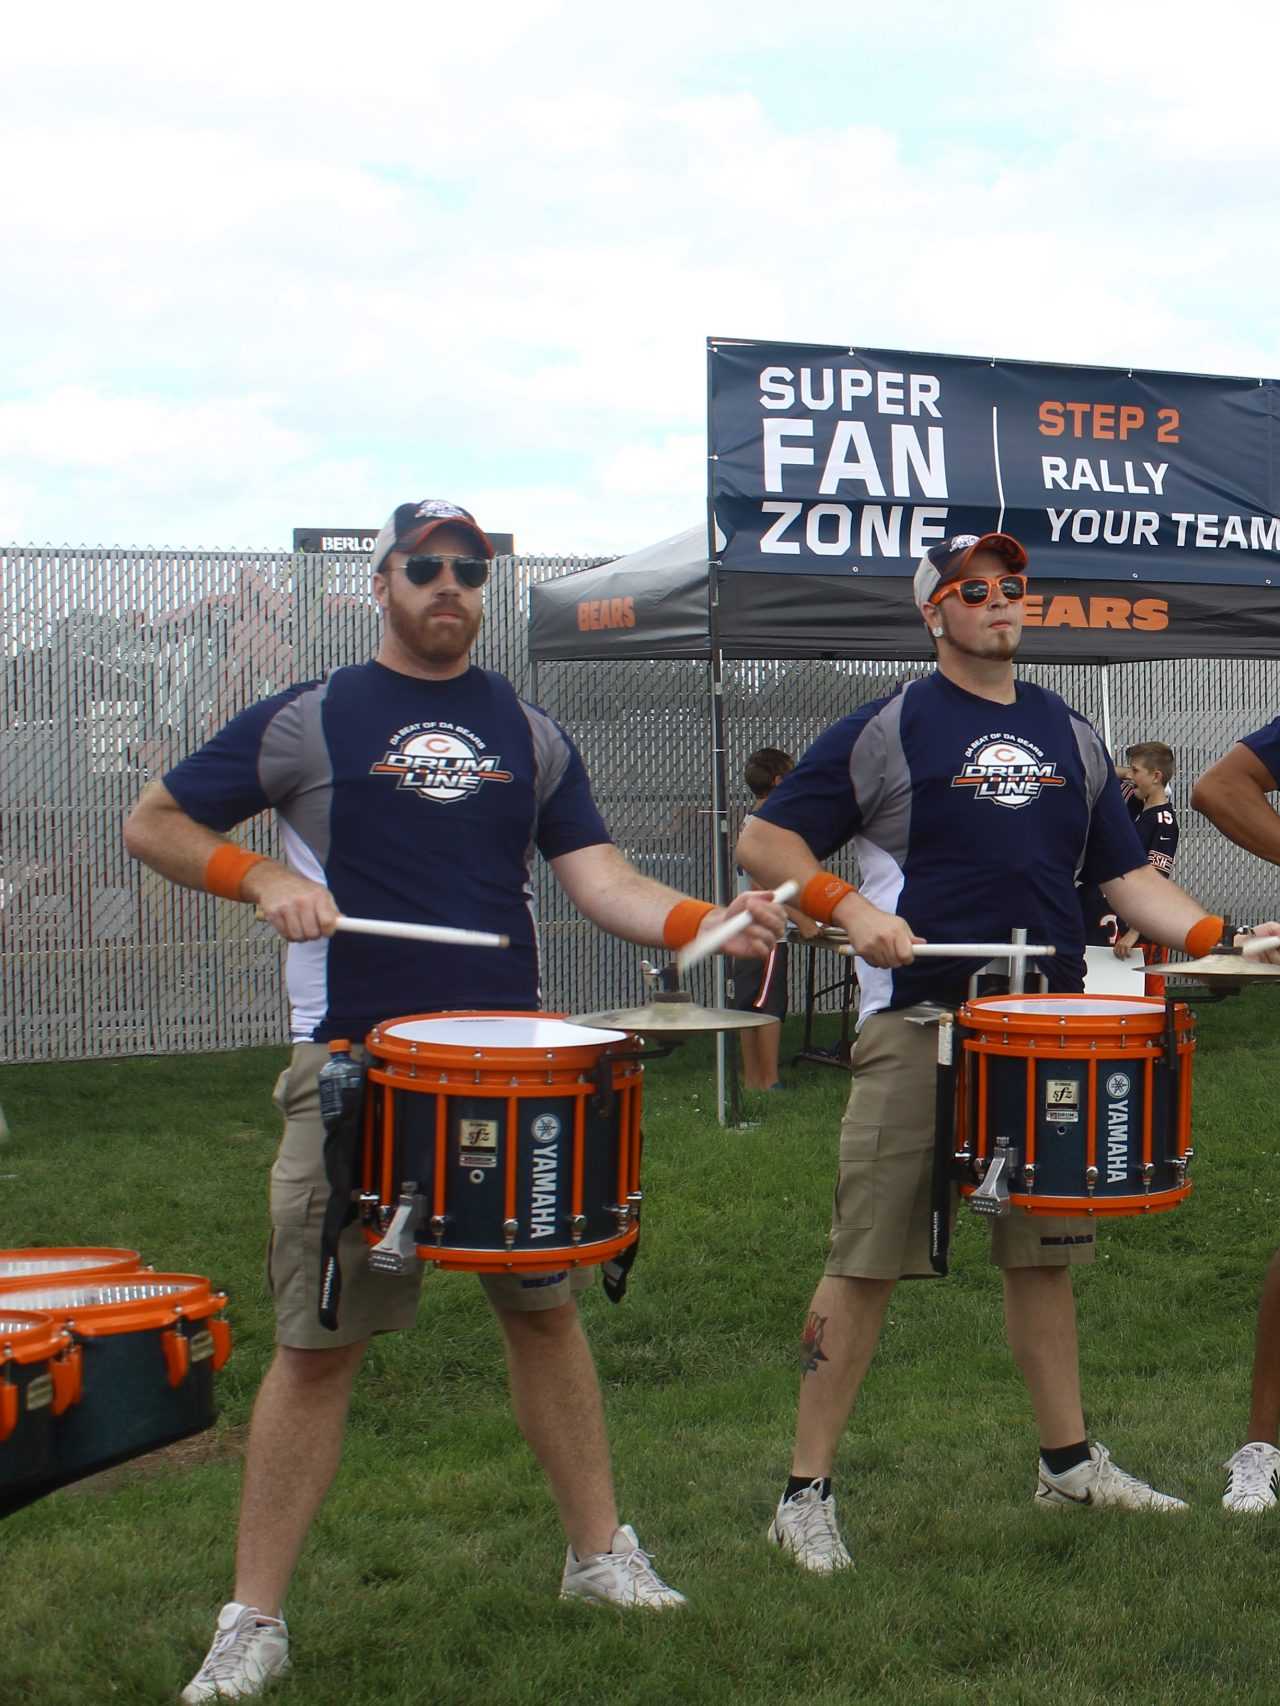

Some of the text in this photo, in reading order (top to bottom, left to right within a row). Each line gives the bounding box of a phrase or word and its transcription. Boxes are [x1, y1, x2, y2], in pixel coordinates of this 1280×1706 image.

[759, 367, 942, 418] SUPER
[1038, 401, 1181, 444] STEP 2
[762, 417, 948, 498] FAN
[1041, 456, 1168, 495] RALLY
[321, 537, 378, 551] BERLO
[759, 501, 948, 557] ZONE
[1045, 507, 1161, 547] YOUR
[577, 597, 636, 631] BEARS
[1022, 595, 1169, 631] EARS
[386, 754, 494, 771] DRUM
[403, 772, 481, 789] LINE
[965, 766, 1052, 777] DRUM
[980, 782, 1040, 795] LINE
[1107, 1100, 1128, 1183] YAMAHA
[531, 1144, 558, 1239] YAMAHA
